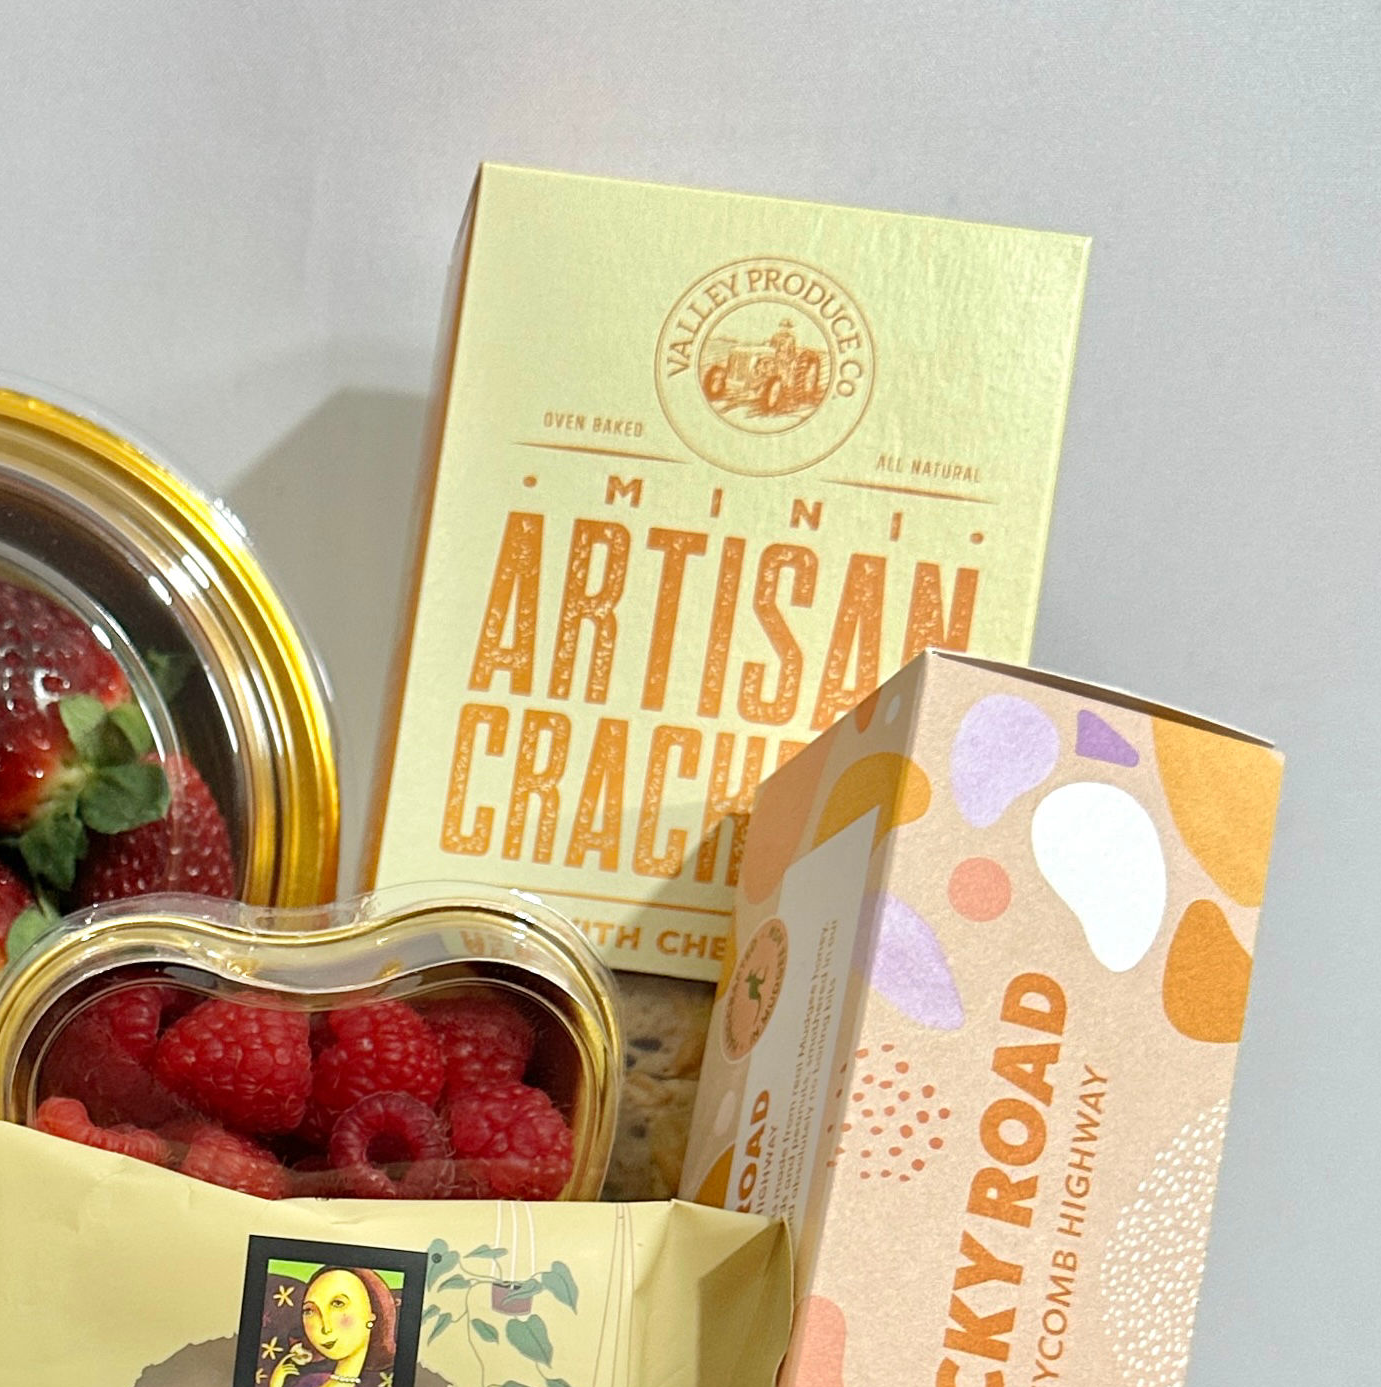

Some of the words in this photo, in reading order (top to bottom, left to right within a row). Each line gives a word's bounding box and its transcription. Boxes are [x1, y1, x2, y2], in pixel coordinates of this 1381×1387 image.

[667, 273, 740, 379] VALLEY
[746, 268, 862, 354] PRODUCE
[544, 411, 586, 432] OVEN
[592, 416, 644, 439] BAKED
[874, 452, 907, 475] ALL
[911, 459, 982, 484] NATURAL
[468, 511, 980, 732] ARTISAN
[440, 702, 809, 888] CRACK
[965, 972, 1069, 1229] ROAD
[1057, 1063, 1109, 1239] HIGHWAY
